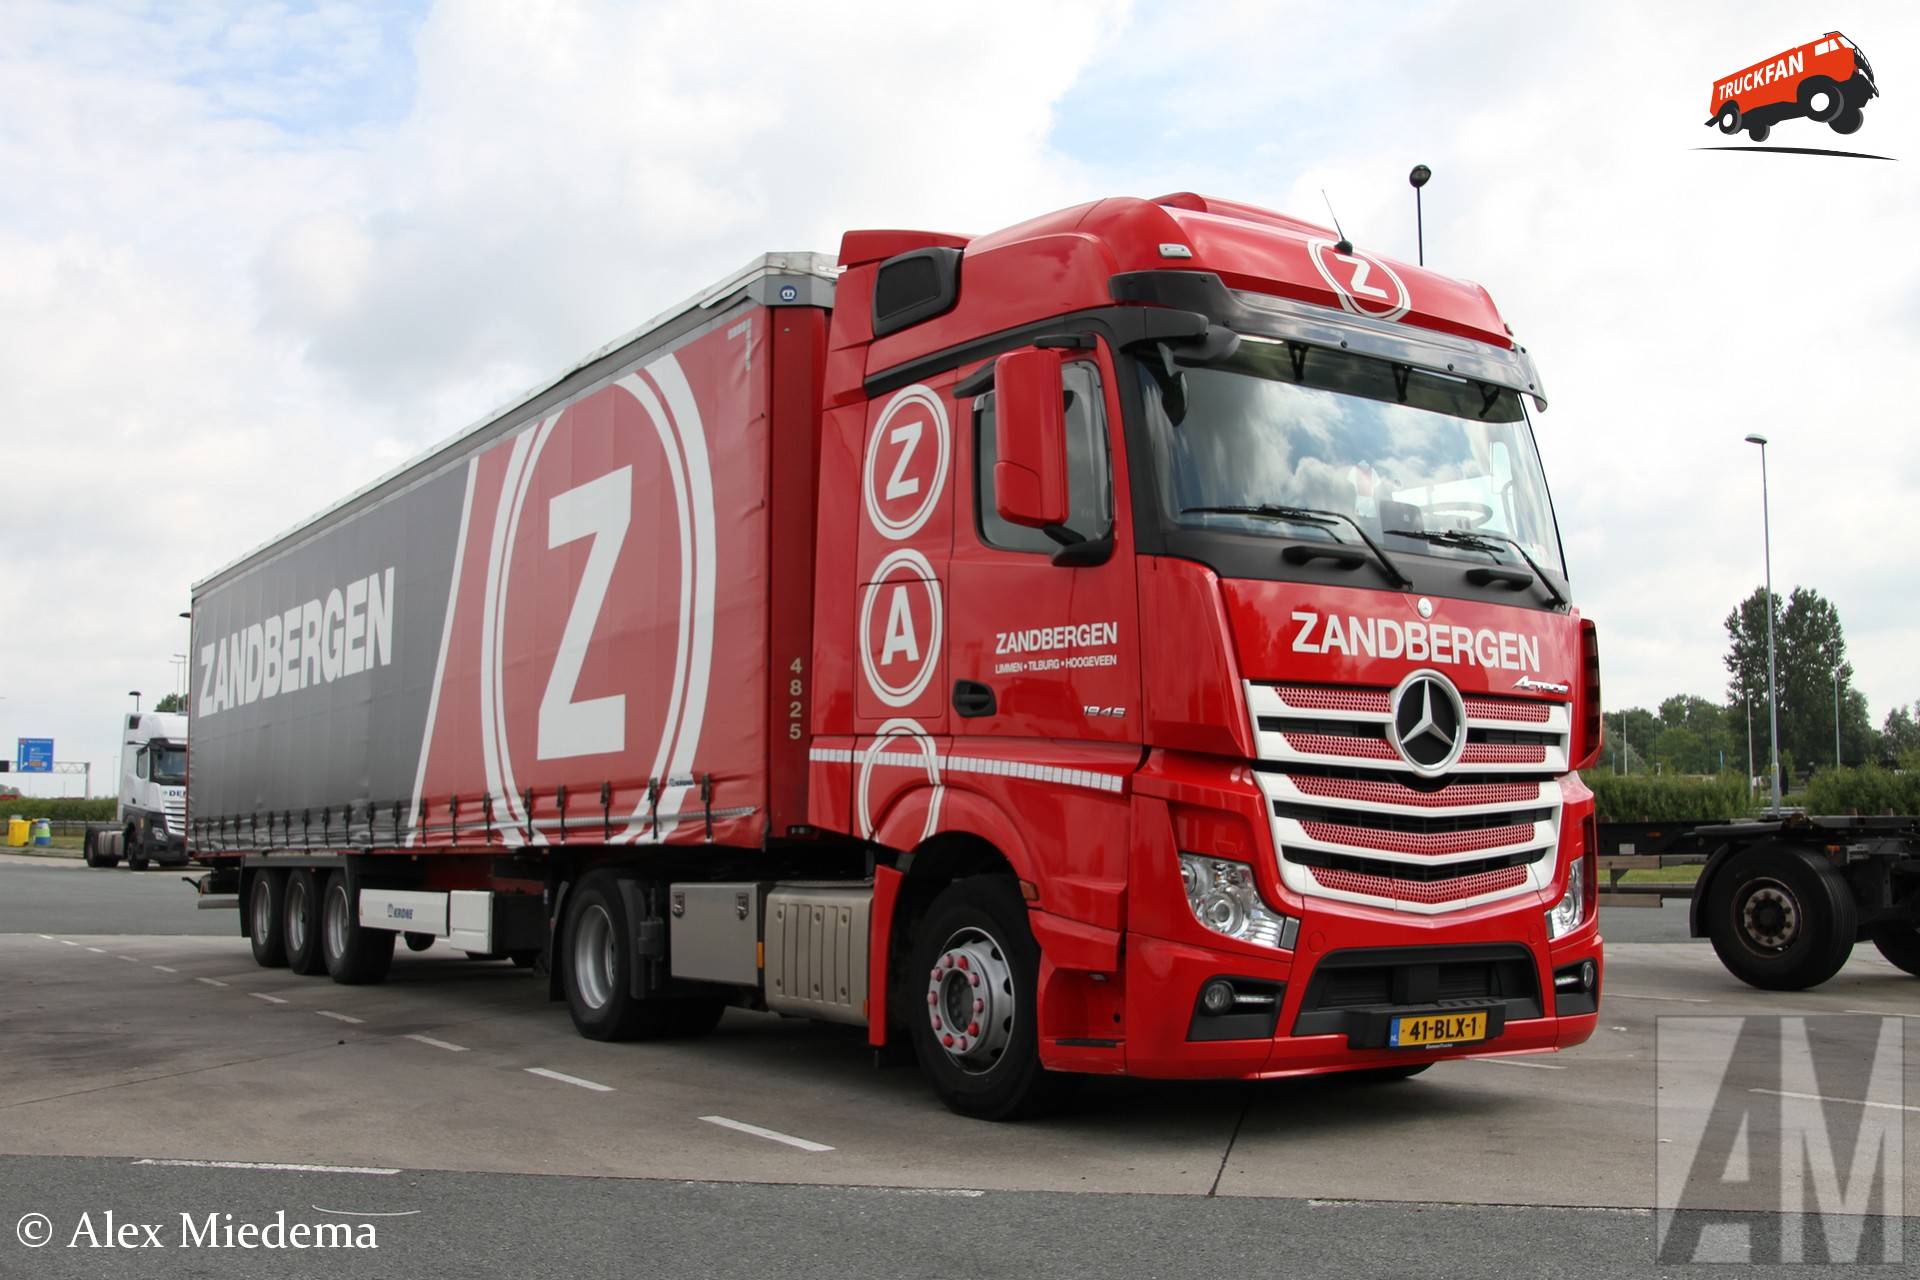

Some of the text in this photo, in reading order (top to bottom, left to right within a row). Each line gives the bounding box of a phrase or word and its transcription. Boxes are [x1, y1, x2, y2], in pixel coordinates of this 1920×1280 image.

[1336, 253, 1388, 299] Z
[886, 420, 923, 501] Z
[199, 567, 395, 718] ZANDBERGEN
[537, 464, 633, 761] Z
[880, 585, 920, 666] A
[995, 621, 1118, 655] ZANDBERGEN
[1291, 611, 1540, 673] ZANDBERGEN
[789, 657, 803, 740] 4825
[995, 654, 1118, 674] LIMMEN TILBURG HOOGEVEEN
[1409, 1016, 1477, 1041] 41-BLX-1
